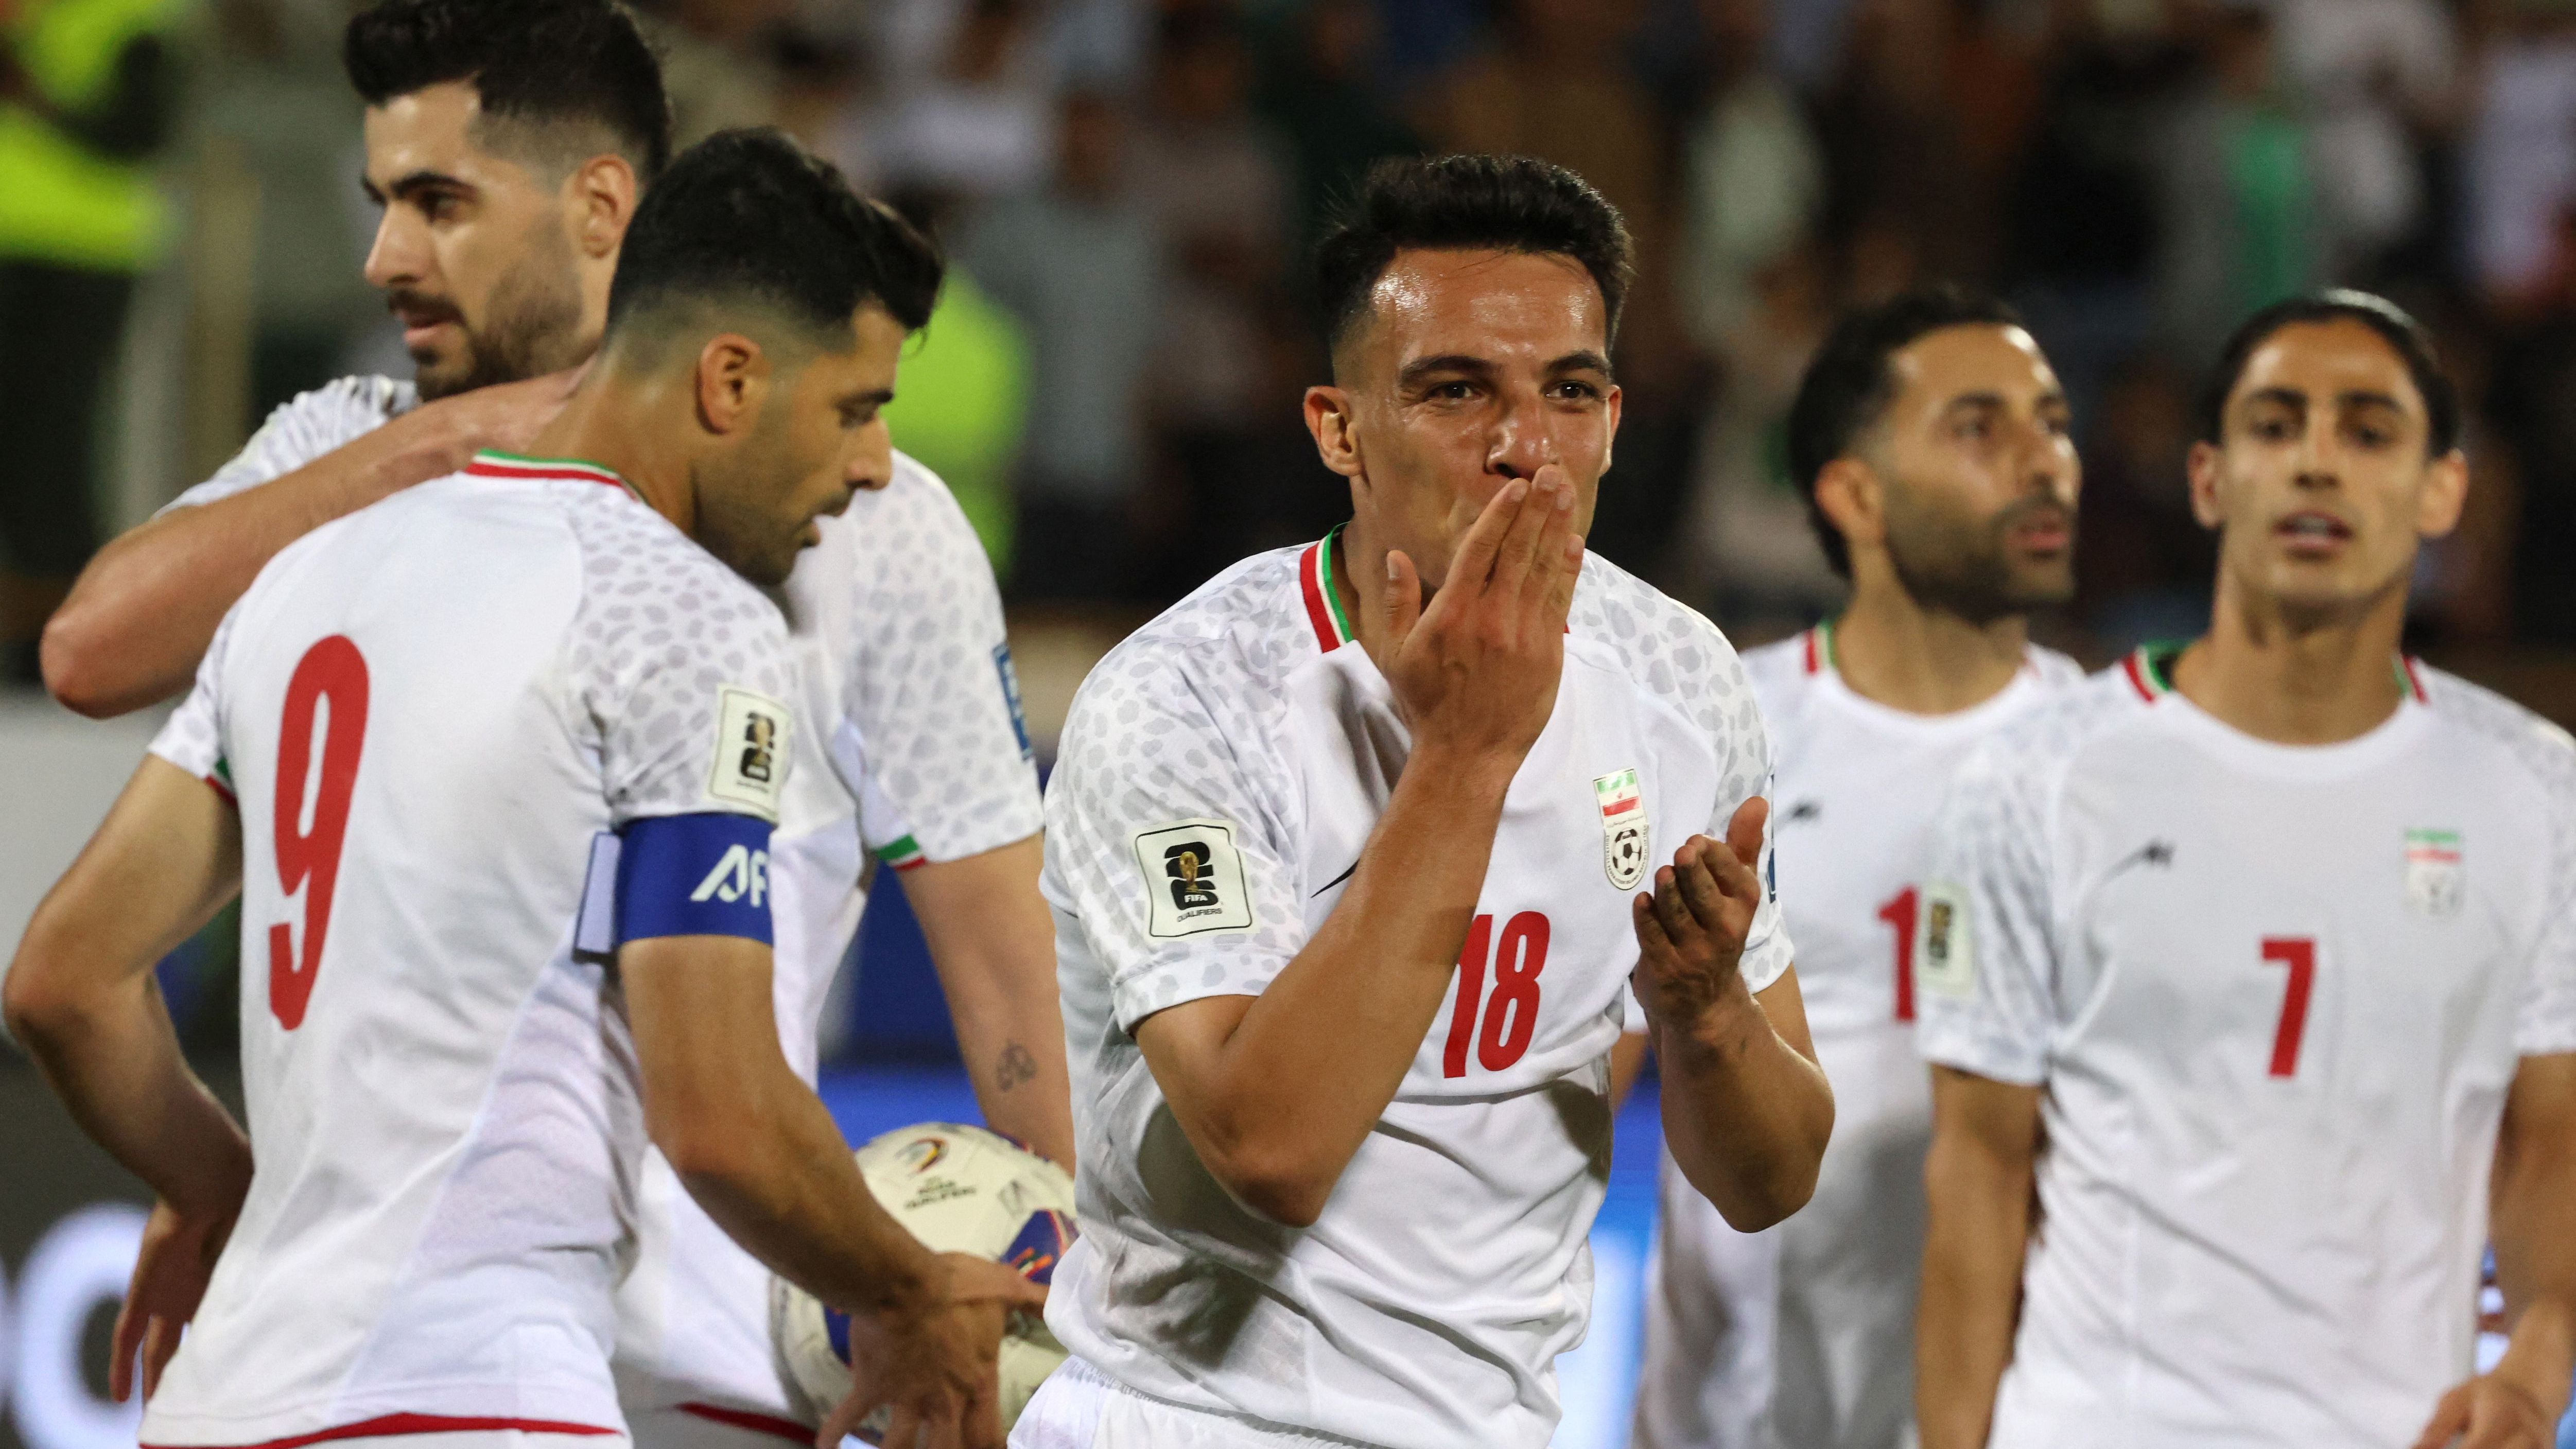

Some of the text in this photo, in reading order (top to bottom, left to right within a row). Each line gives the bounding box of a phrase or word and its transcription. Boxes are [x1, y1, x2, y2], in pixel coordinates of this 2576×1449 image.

[268, 634, 370, 1031] 9
[1184, 894, 1209, 903] FIFA
[1177, 908, 1223, 922] QUALIFIERS
[1443, 911, 1551, 1078] 18
[2261, 938, 2315, 1078] 7
